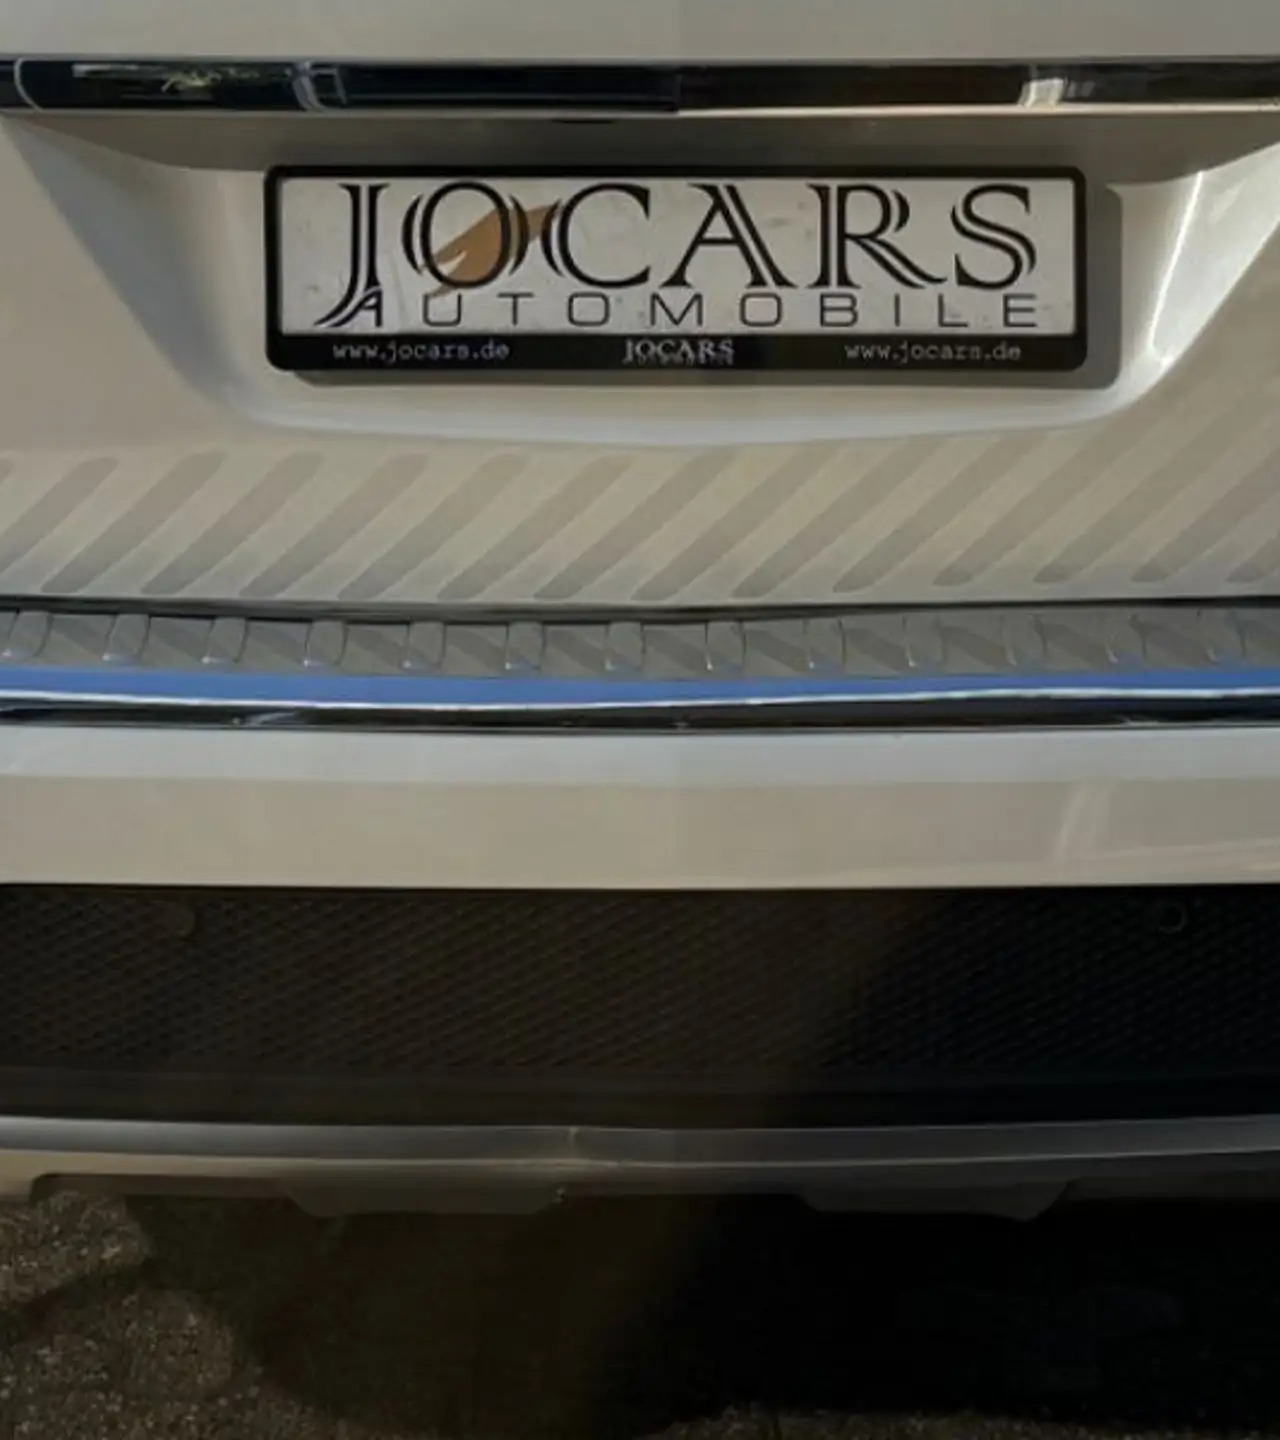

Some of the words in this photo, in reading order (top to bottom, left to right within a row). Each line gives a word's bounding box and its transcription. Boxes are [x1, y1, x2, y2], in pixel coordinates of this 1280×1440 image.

[313, 181, 1037, 327] JOCARS
[327, 291, 1038, 328] AUTOMOBILE
[332, 338, 510, 364] www.jocars.de
[622, 338, 735, 365] JOCARS
[844, 339, 1022, 364] www.jocars.de
